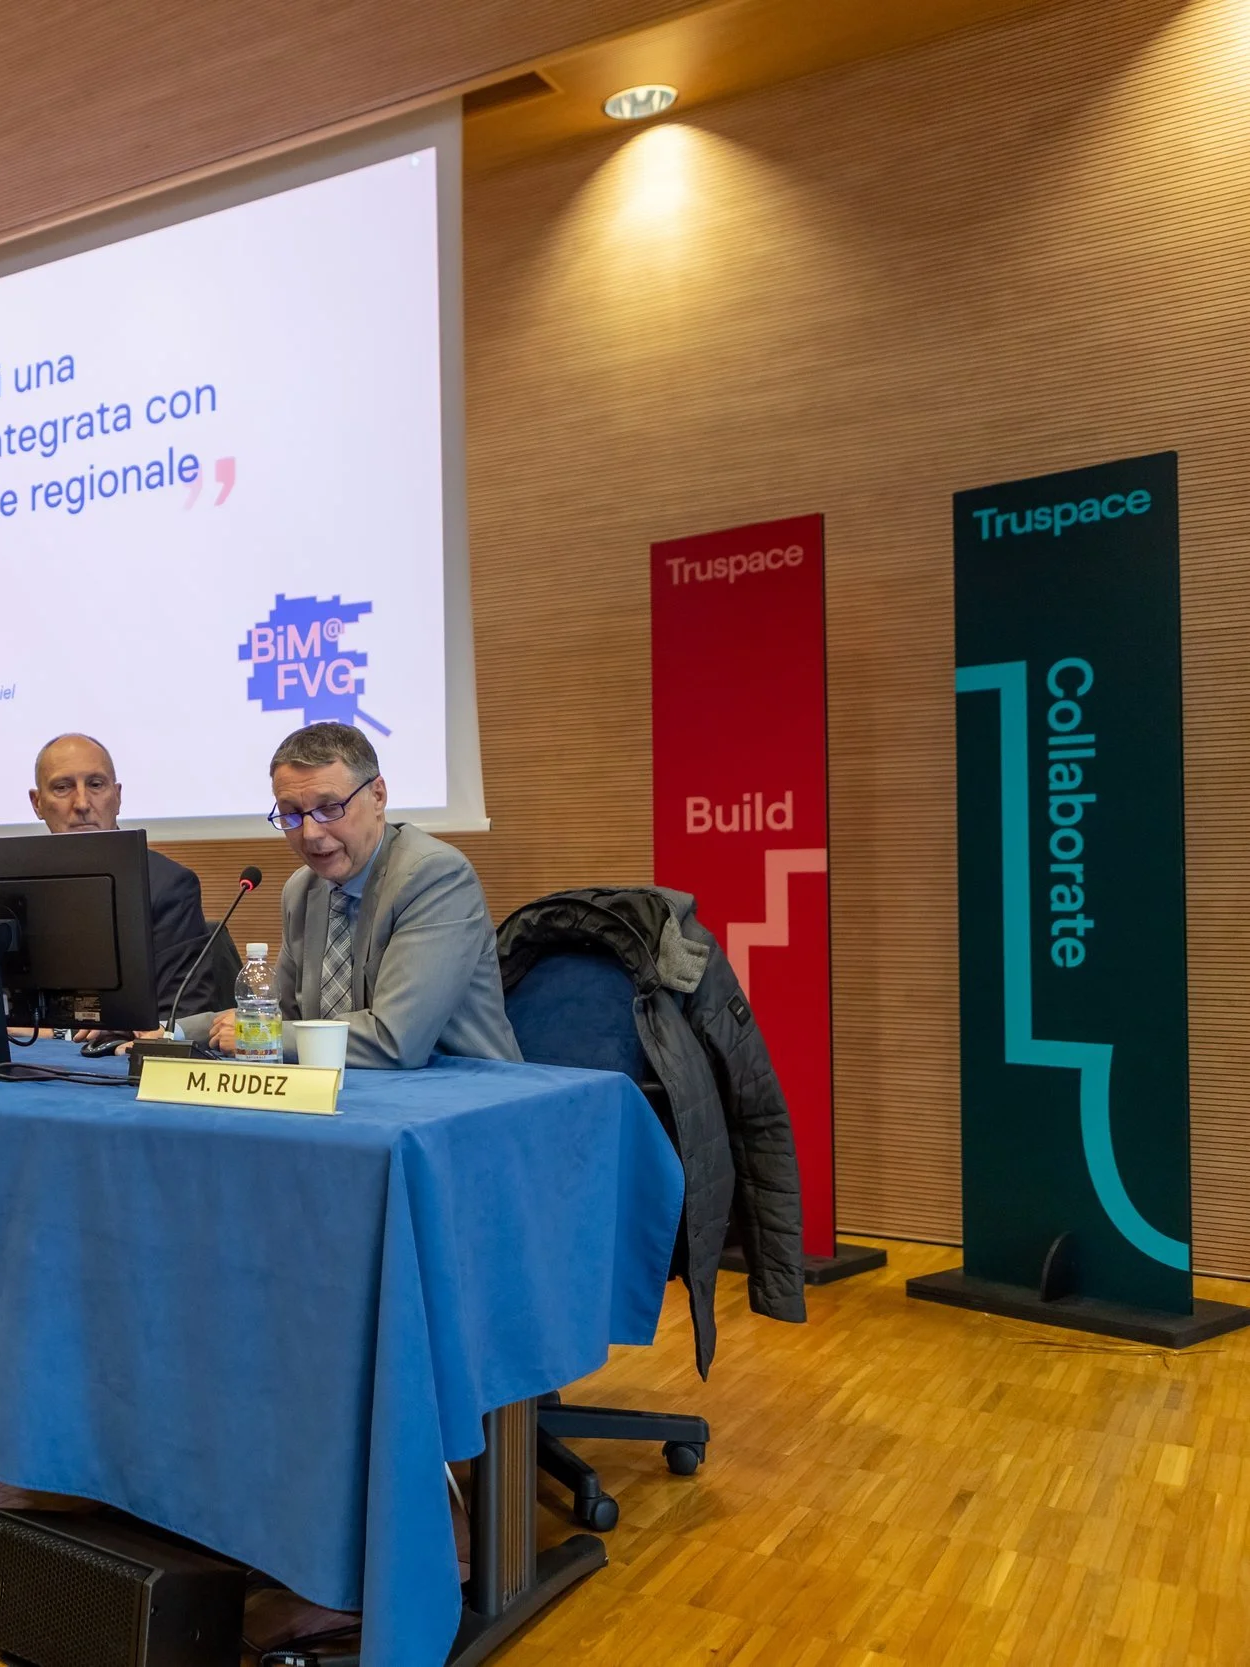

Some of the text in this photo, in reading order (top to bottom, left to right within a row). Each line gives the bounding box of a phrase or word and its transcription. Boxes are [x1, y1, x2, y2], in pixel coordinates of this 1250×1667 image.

[14, 354, 75, 393] una
[145, 383, 217, 425] con
[31, 446, 200, 514] regionale
[972, 487, 1152, 541] Truspace
[665, 542, 804, 586] Truspace
[277, 658, 356, 700] FVG
[684, 790, 794, 835] Build
[1046, 656, 1096, 968] Collaborate
[186, 1071, 288, 1096] M. RUDEZ
